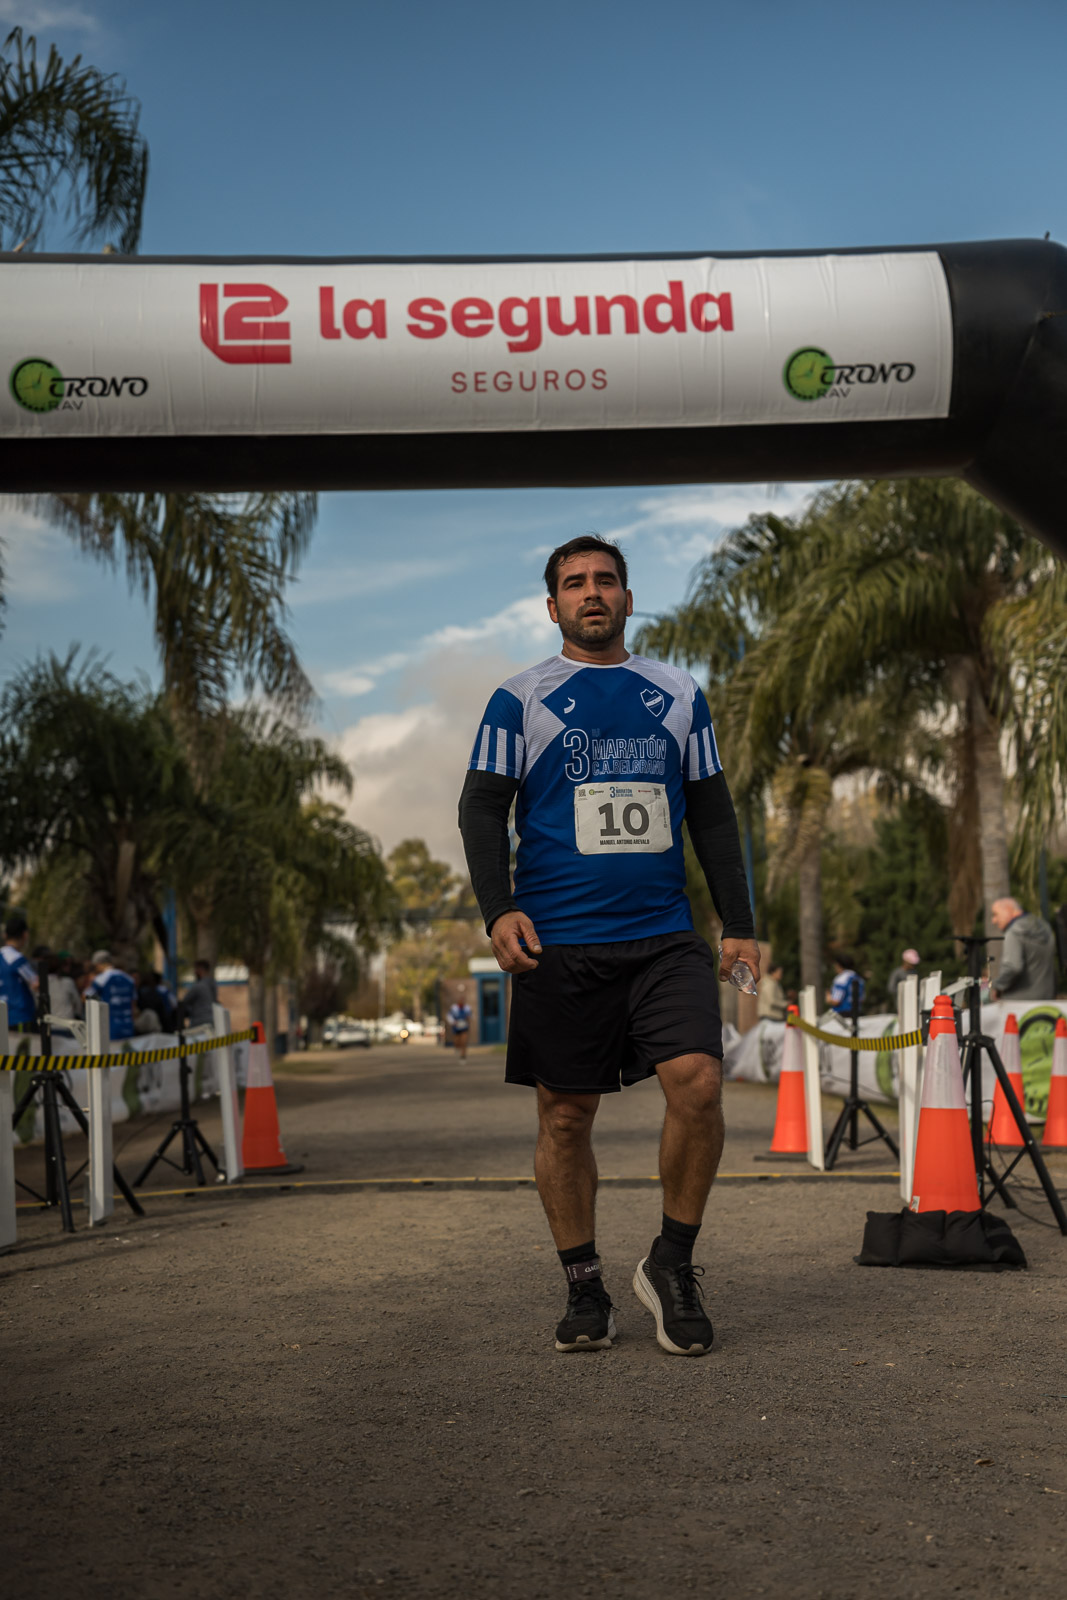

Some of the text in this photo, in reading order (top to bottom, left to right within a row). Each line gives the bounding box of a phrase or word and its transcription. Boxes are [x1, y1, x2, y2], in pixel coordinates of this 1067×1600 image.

[319, 280, 734, 353] la segunda
[451, 368, 608, 393] SEGUROS
[563, 728, 667, 782] 3 MARATÓN
[598, 802, 650, 837] 10
